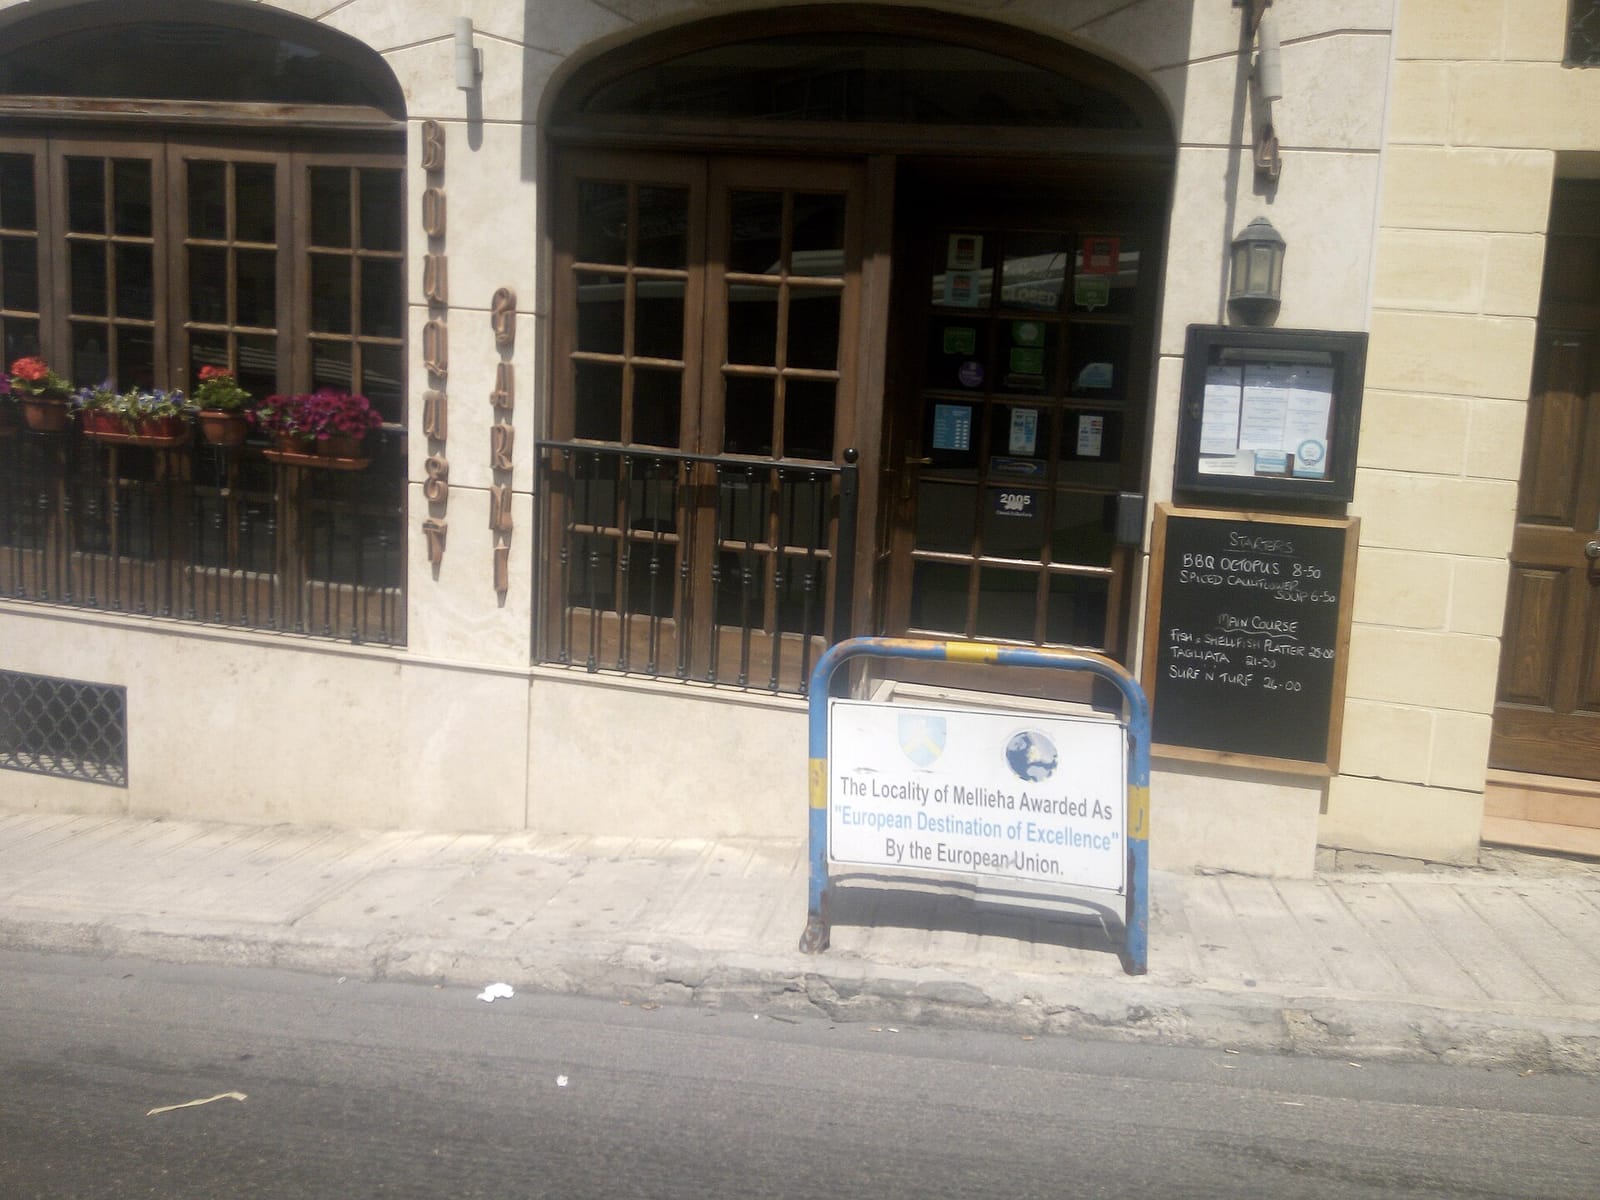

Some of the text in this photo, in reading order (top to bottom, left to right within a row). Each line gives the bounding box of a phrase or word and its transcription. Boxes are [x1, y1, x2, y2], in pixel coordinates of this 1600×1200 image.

[999, 493, 1031, 505] 2005
[1183, 552, 1215, 570] BBQ
[1220, 557, 1281, 576] OCTOPUS
[1179, 569, 1224, 586] SPICED
[1251, 615, 1300, 633] COURSE
[1168, 646, 1231, 664] TAGLIATA
[1263, 638, 1305, 657] PLATTER
[1168, 664, 1201, 680] SURF
[1219, 672, 1254, 687] TURF
[840, 776, 1113, 821] The Locality of Mellieha Awarded As
[835, 804, 1119, 851] "European Destination of Excellence"
[885, 838, 1065, 876] By the European Union.
